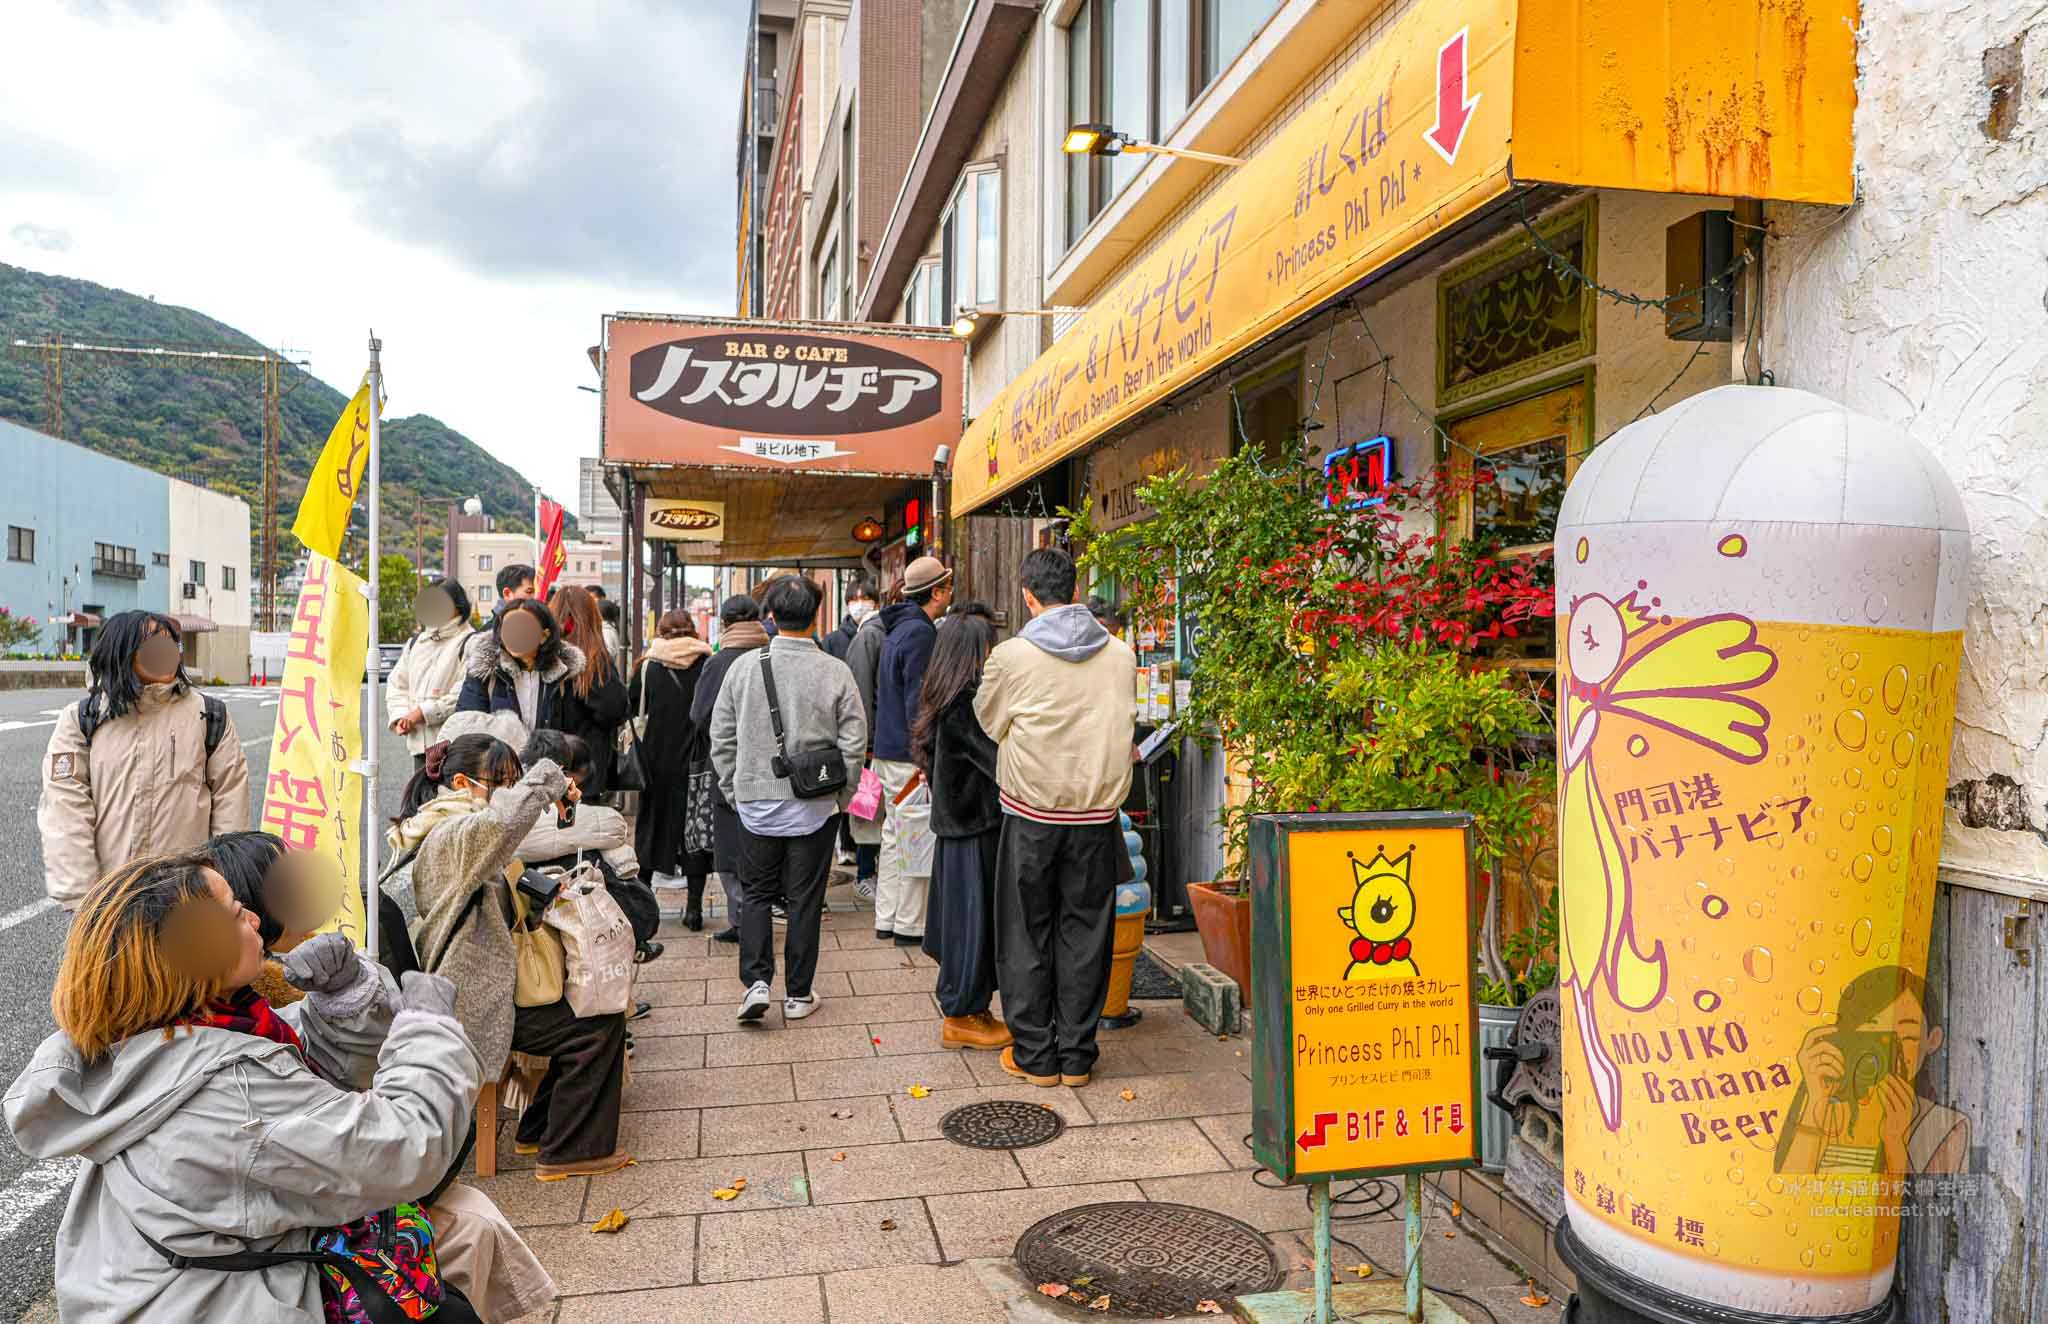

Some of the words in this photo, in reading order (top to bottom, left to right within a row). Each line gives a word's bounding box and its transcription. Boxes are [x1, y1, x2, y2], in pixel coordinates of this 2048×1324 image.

[1276, 223, 1337, 286] Princess
[1104, 203, 1237, 377] バナナビア
[725, 341, 768, 359] BAR
[774, 344, 790, 360] &
[795, 345, 849, 363] CAFE
[1091, 384, 1119, 418] Banana
[1146, 357, 1154, 384] in
[1157, 344, 1173, 376] the
[1177, 312, 1212, 362] world
[636, 345, 938, 415] ノスタルヂア
[754, 441, 821, 458] 当ビル地下
[1614, 773, 1724, 826] 門司港
[1630, 796, 1812, 864] バナナビア
[1296, 978, 1461, 1002] 世界にひとつだけの焼きカレー
[1305, 1003, 1325, 1016] Only
[1328, 1004, 1344, 1014] one
[1347, 1001, 1374, 1013] Grilled
[1377, 1000, 1399, 1013] Curry
[1402, 998, 1410, 1008] in
[1413, 997, 1427, 1008] the
[1429, 996, 1454, 1008] world
[1297, 1033, 1383, 1067] Princess
[1611, 1020, 1748, 1065] MOJIKO
[1642, 1061, 1791, 1104] Banana
[1346, 1109, 1385, 1142] B1F
[1395, 1108, 1408, 1137] &
[1422, 1105, 1444, 1135] 1F
[1680, 1108, 1779, 1146] Beer
[1573, 1168, 1706, 1248] 登録商標
